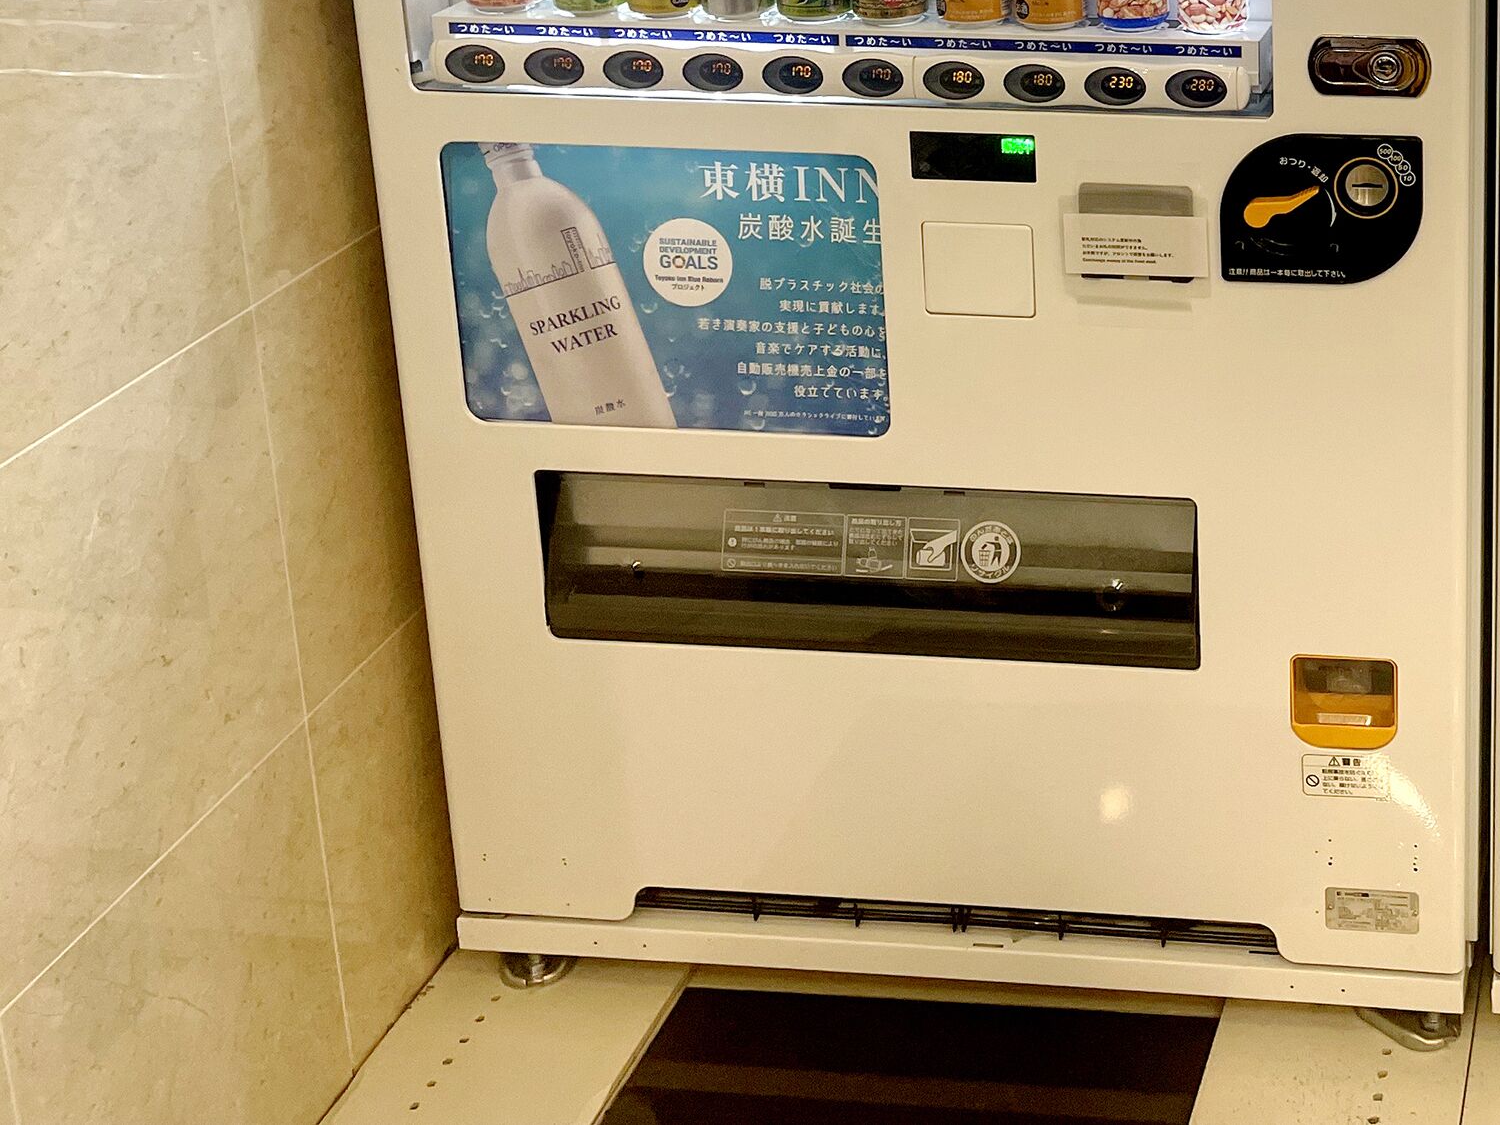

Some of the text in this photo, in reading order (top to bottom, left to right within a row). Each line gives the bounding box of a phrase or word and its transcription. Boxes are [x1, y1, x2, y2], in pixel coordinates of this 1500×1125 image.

[952, 70, 972, 84] 180
[1110, 75, 1133, 89] 230
[1191, 78, 1214, 91] 280
[738, 213, 881, 245] 炭酸水誕生
[659, 237, 718, 247] SUSTAINABLE
[659, 255, 719, 271] GOALS
[529, 295, 622, 336] SPARKLING
[550, 322, 618, 356] WATER
